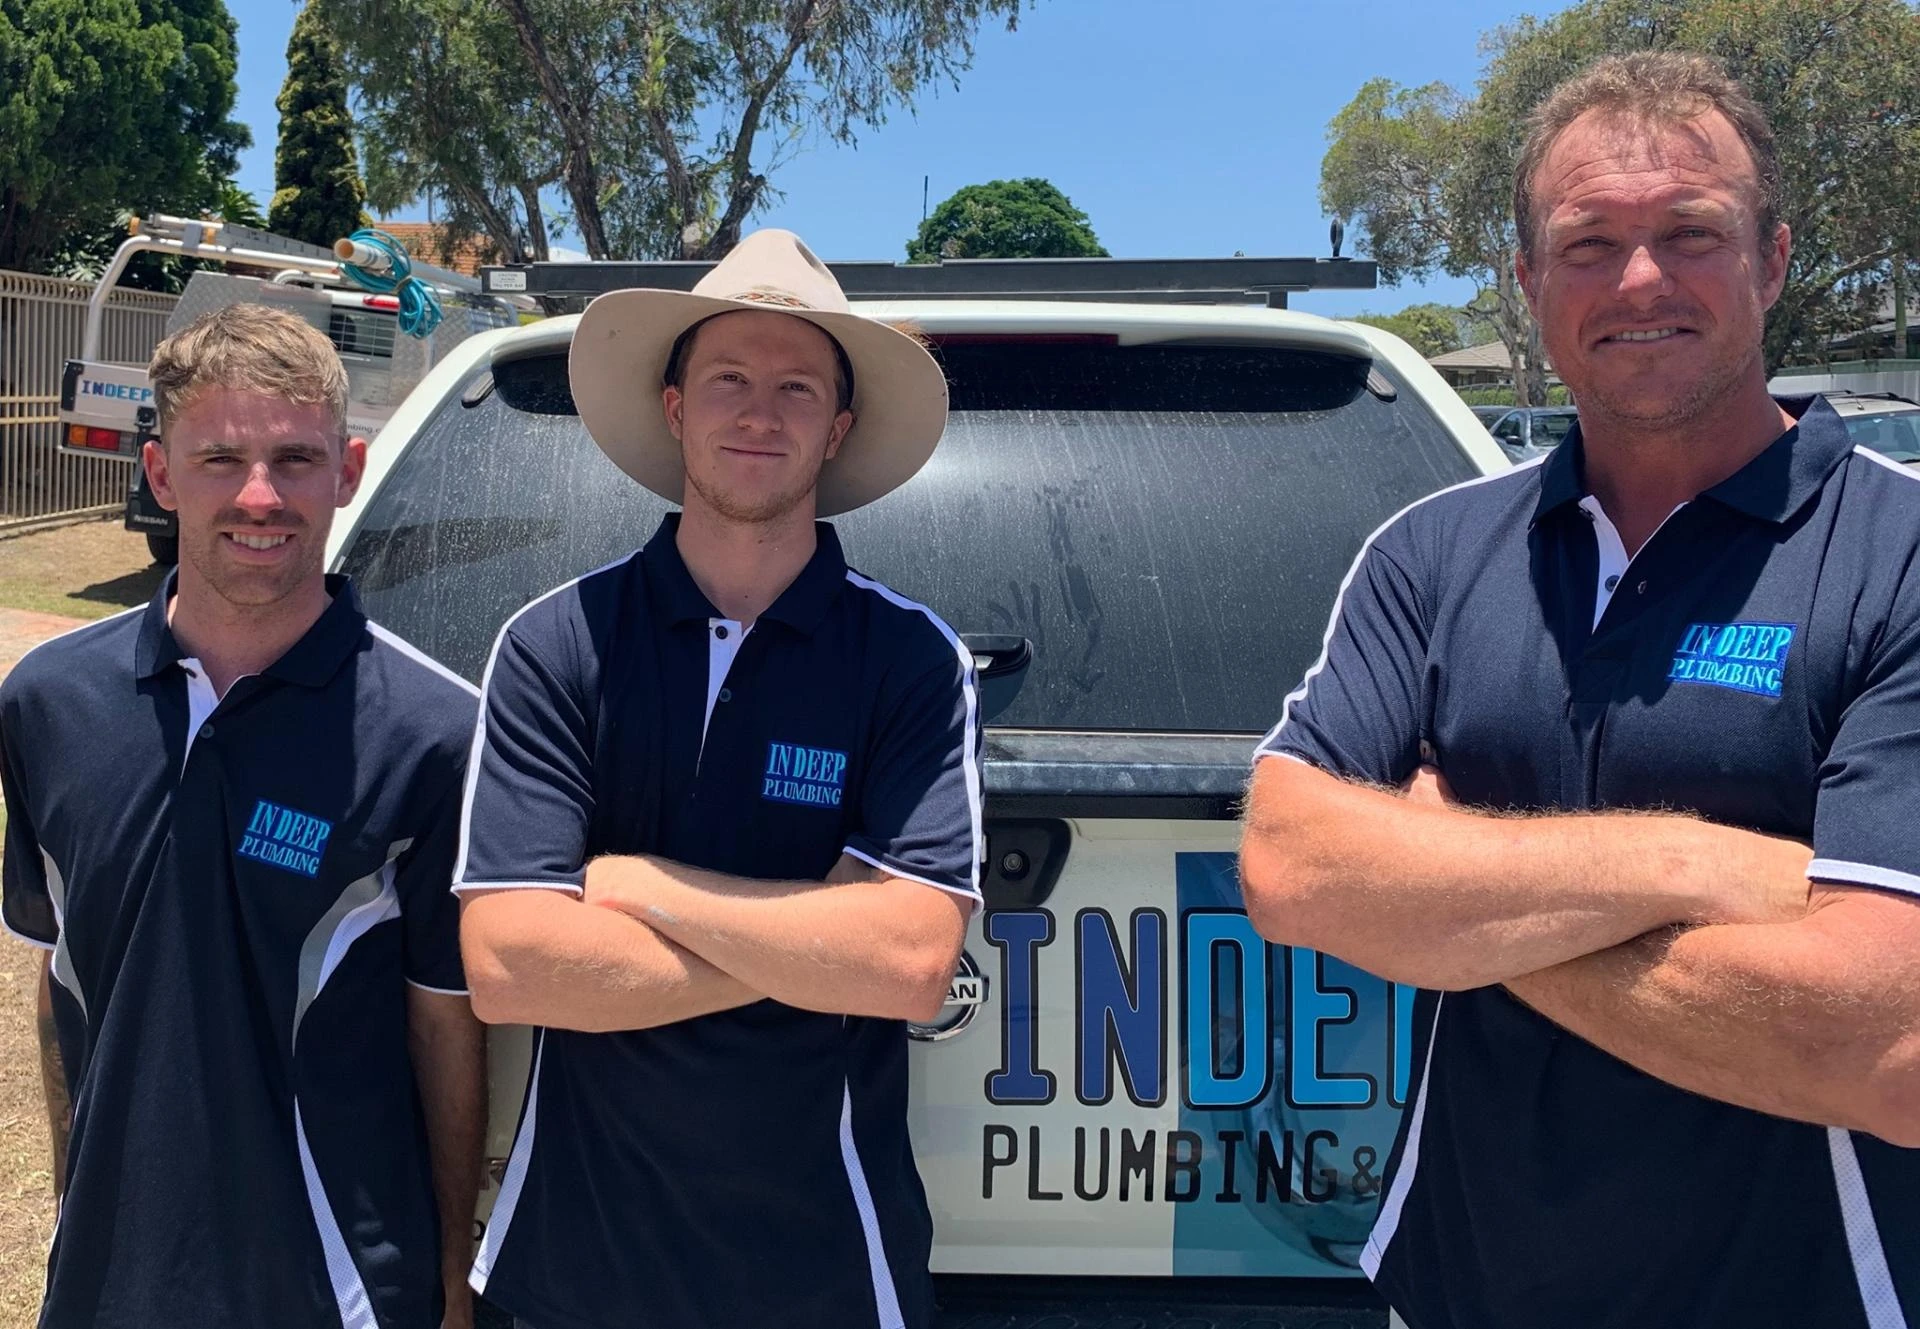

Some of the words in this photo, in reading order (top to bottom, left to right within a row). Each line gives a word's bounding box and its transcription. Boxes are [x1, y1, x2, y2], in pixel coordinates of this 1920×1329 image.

[82, 380, 153, 402] INDEEP
[1676, 624, 1720, 656] IN
[1714, 625, 1792, 662] DEEP
[1667, 658, 1782, 691] PLUMBING
[766, 743, 793, 777] IN
[792, 747, 847, 784] DEEP
[762, 778, 842, 805] PLUMBING
[247, 800, 280, 837] IN
[273, 808, 331, 853] DEEP
[238, 834, 320, 875] PLUMBING
[947, 983, 977, 999] AN
[983, 906, 1416, 1111] INDE
[982, 1124, 1340, 1204] PLUMBING
[1351, 1145, 1382, 1197] &
